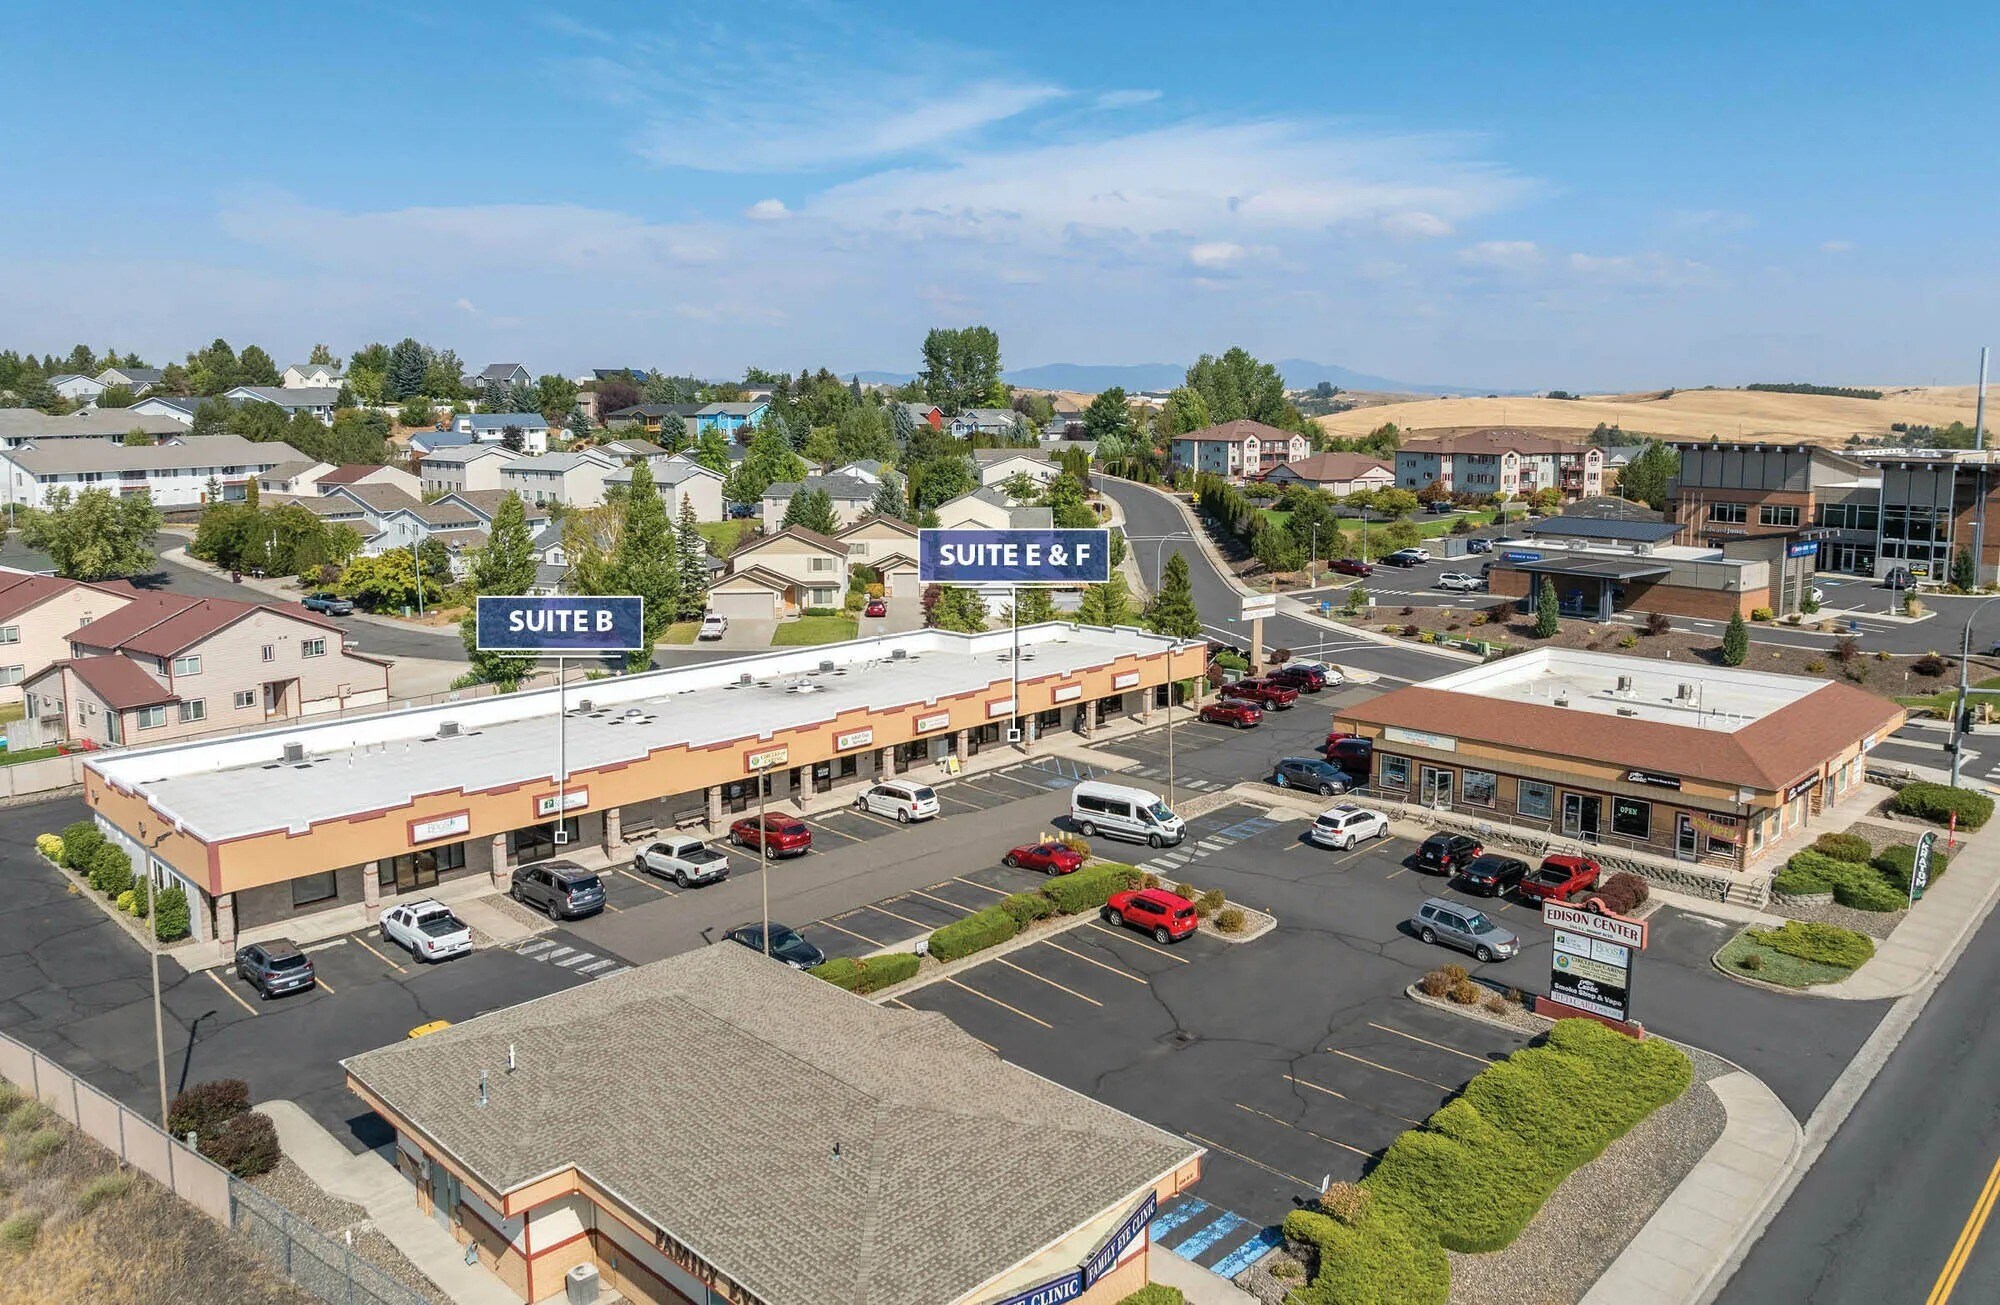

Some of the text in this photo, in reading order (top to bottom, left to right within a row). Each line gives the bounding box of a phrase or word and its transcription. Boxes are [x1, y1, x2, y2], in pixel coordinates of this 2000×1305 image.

[1620, 806, 1638, 815] OPEN
[1916, 842, 1930, 888] KRATOM
[1547, 908, 1638, 941] EDISON CENTER
[1554, 982, 1578, 994] Smoke
[1579, 989, 1596, 1000] Shop
[1597, 994, 1603, 1002] &
[1604, 996, 1623, 1007] Vape
[656, 1228, 718, 1286] FAMILY
[1088, 1199, 1156, 1282] FAMILY EYE CLINIC
[1031, 1280, 1078, 1305] CLINIC
